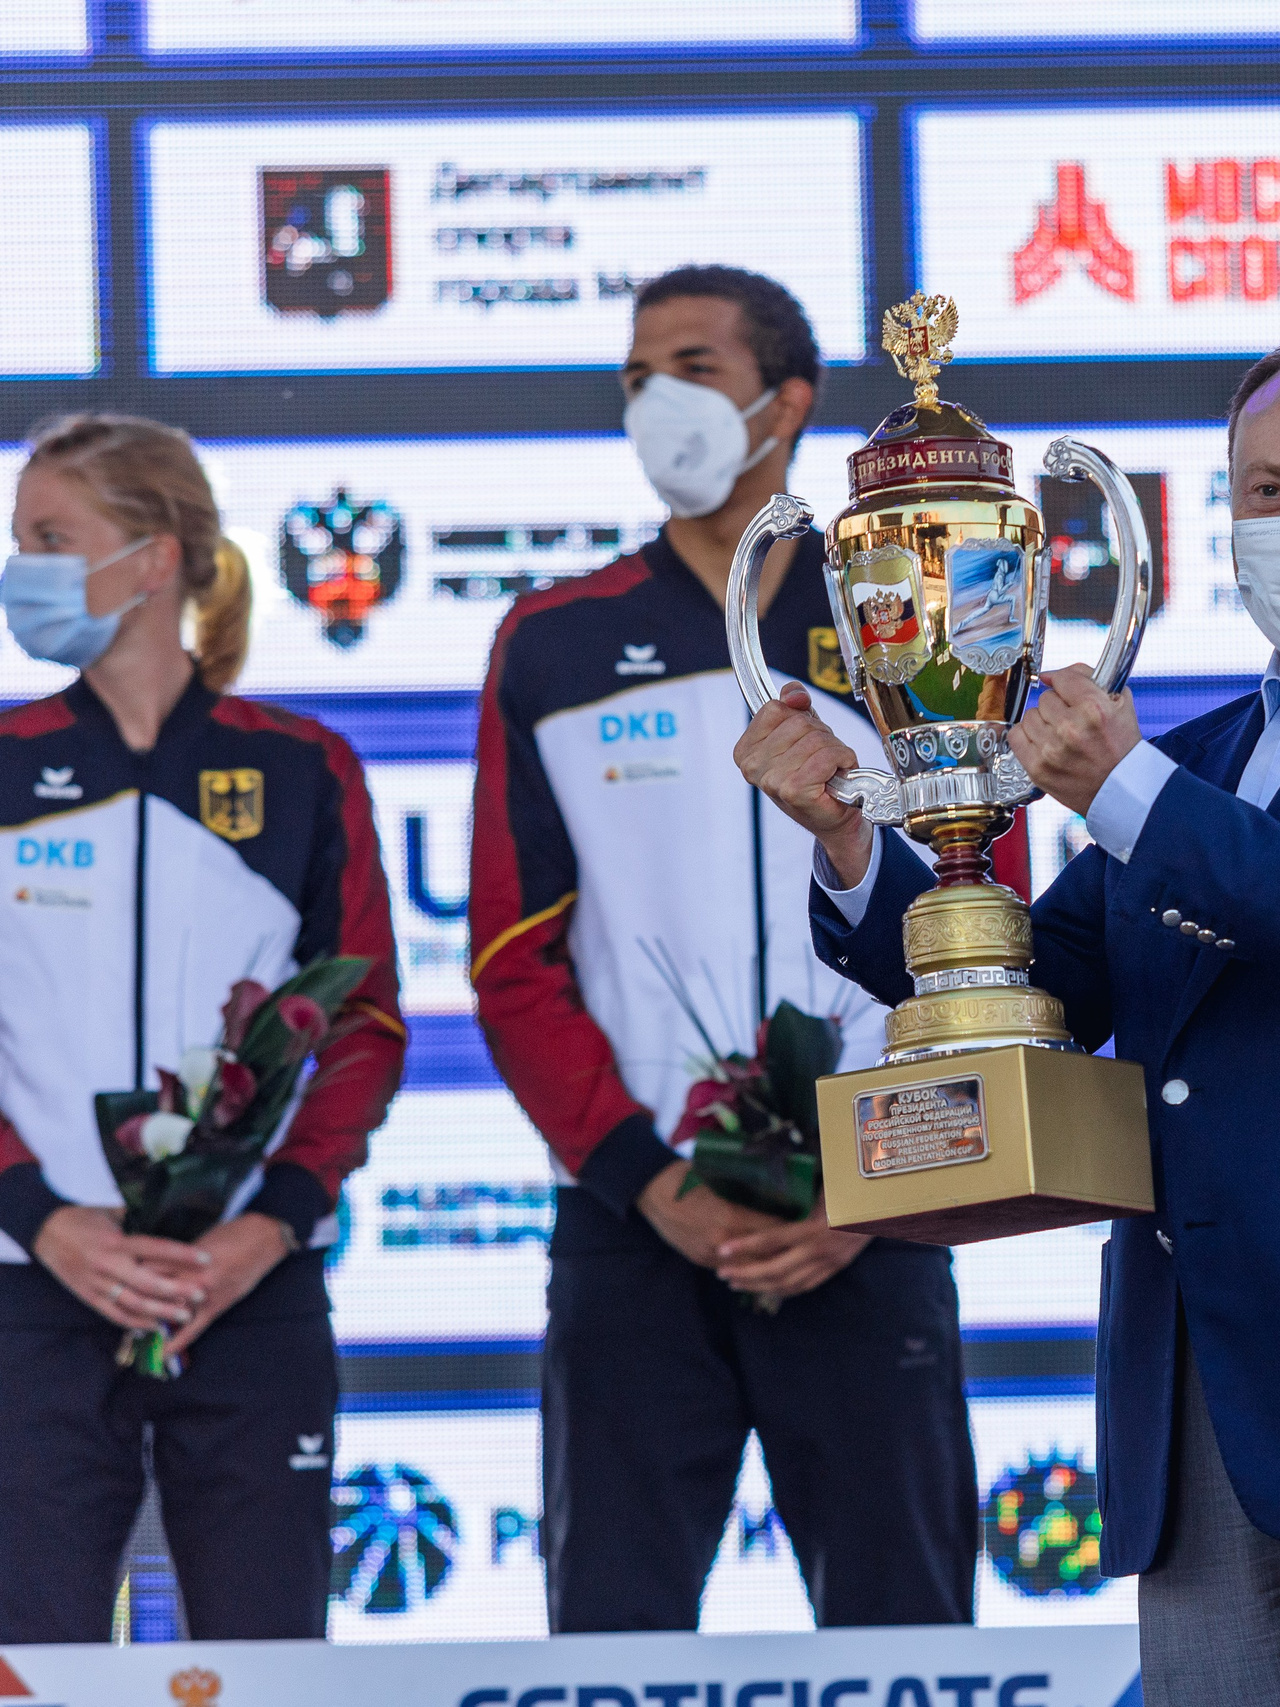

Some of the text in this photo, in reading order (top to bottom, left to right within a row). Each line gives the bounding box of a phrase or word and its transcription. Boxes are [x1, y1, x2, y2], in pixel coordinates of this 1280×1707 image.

[858, 450, 979, 480] ПРЕЗИДЕНТА
[599, 709, 678, 743] DKB
[16, 837, 95, 869] DKB
[891, 1099, 947, 1116] ПРЕЗИДЕНТА
[898, 1087, 939, 1104] КУБОК
[862, 1115, 980, 1142] ПО СОВРЕМЕННОМУ ПЯТИБОРЬЮ
[868, 1105, 973, 1131] РОССИЙСКОЙ ФЕДЕРАЦИИ
[881, 1130, 962, 1149] RUSSIAN FEDERATION
[874, 1145, 973, 1168] MODERN PENTATHLON CUP
